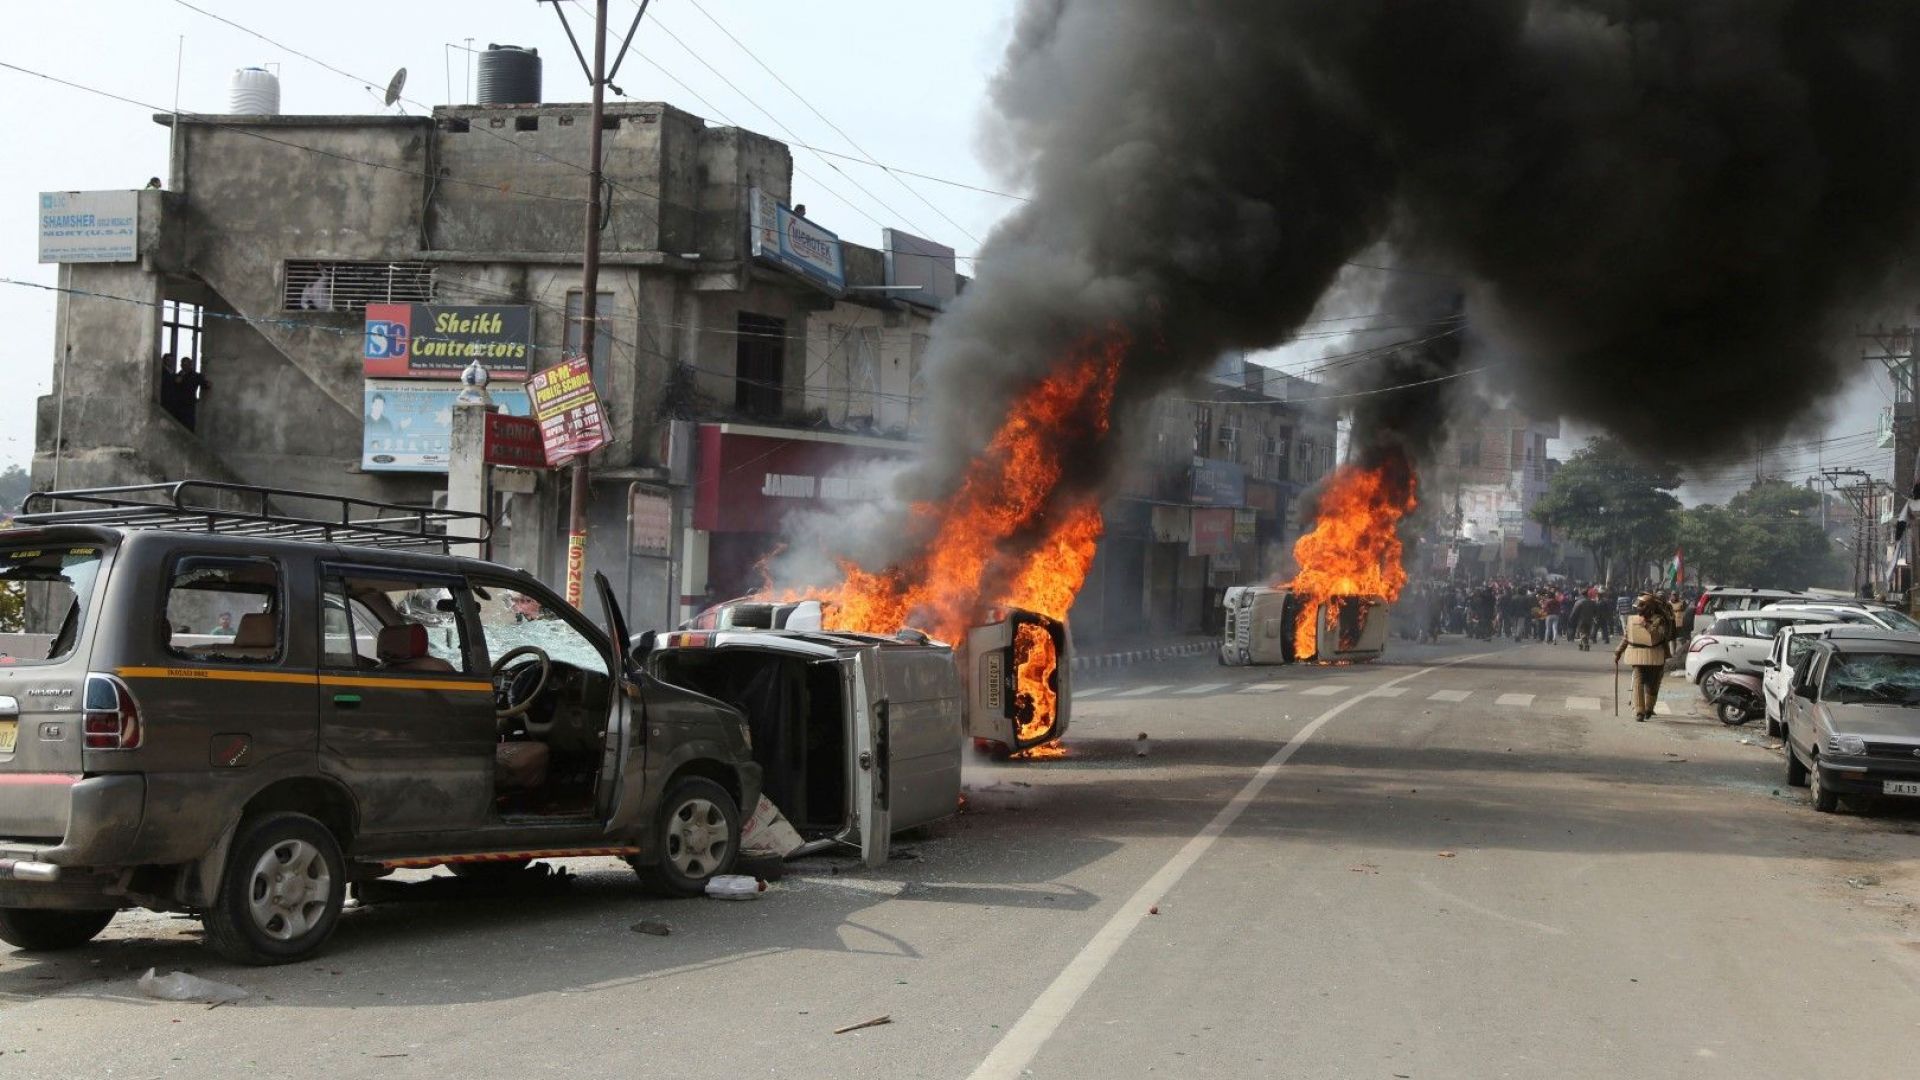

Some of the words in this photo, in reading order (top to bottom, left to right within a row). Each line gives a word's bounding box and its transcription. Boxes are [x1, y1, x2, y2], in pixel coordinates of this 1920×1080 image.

[43, 214, 95, 228] SHAMSHER
[435, 312, 502, 334] Sheikh
[412, 336, 525, 358] Contractors
[537, 383, 562, 403] PUBLIC
[562, 372, 591, 393] SCHOOL
[1907, 785, 1918, 794] 19
